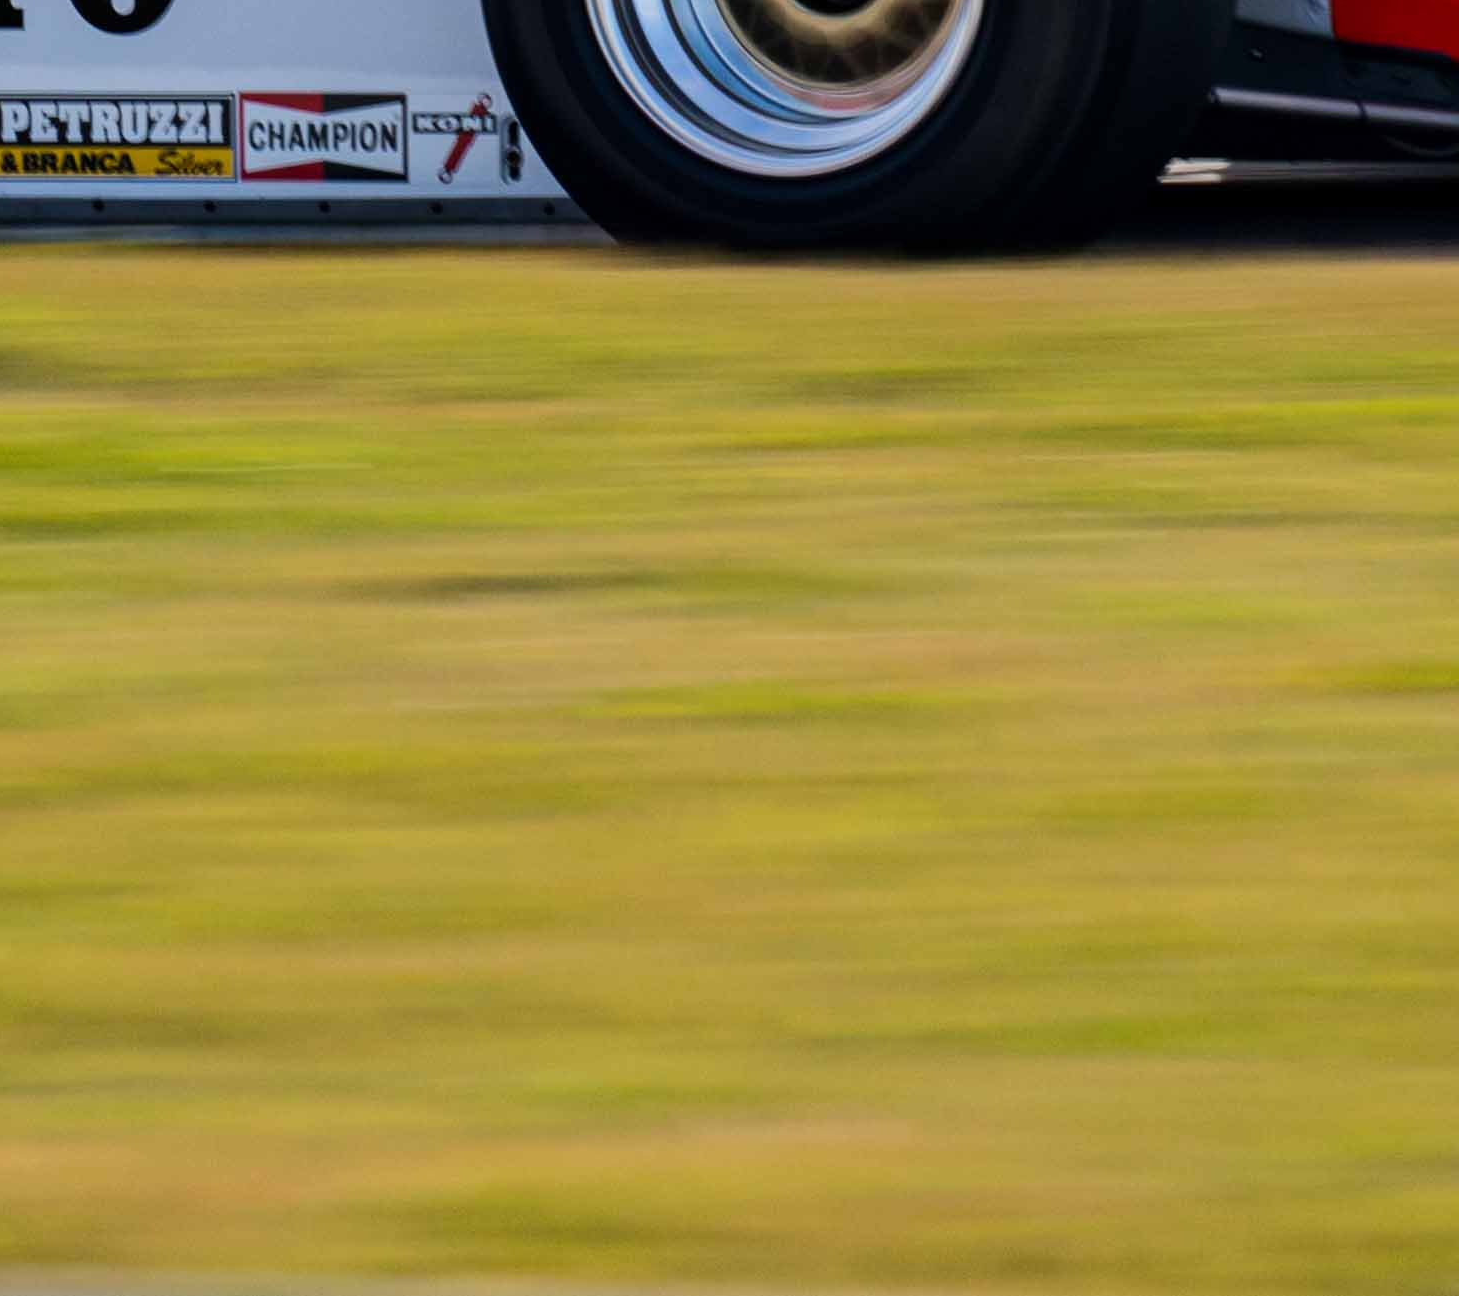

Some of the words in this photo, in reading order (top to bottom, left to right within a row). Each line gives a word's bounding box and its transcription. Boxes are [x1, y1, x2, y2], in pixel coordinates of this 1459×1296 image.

[0, 99, 225, 144] PETRUZZI
[247, 116, 399, 154] CHAMPION
[414, 114, 496, 133] KONI
[0, 152, 19, 175] &
[21, 151, 136, 175] BRANCA
